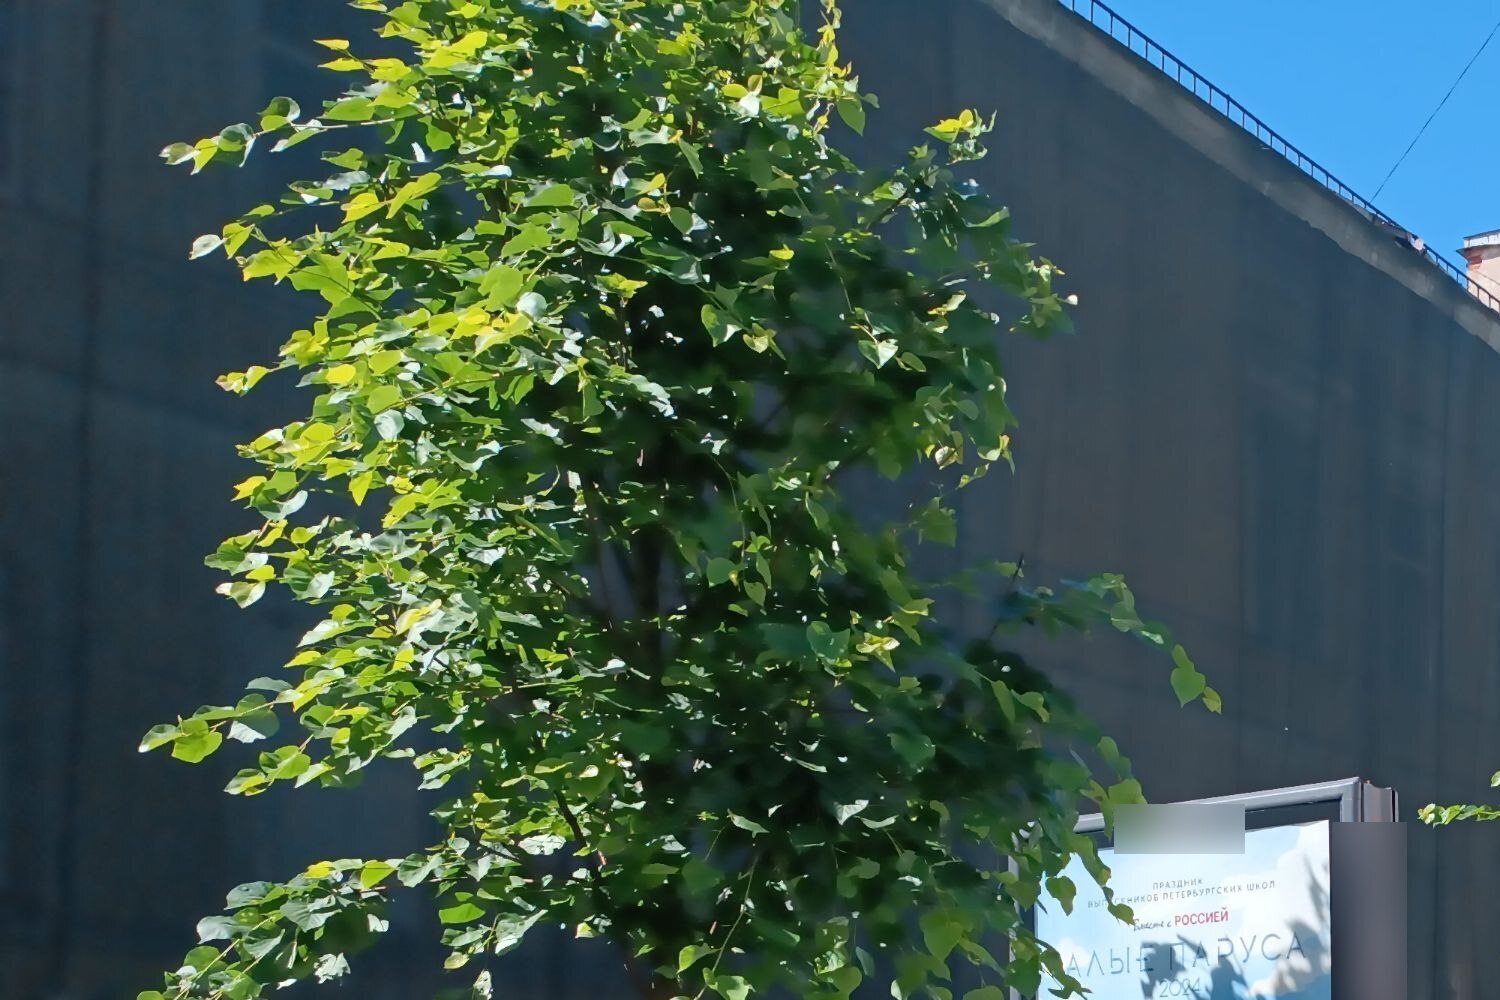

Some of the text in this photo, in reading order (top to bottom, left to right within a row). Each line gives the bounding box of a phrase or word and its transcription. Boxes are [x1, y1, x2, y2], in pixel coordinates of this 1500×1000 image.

[1152, 878, 1203, 890] ПРАЗДНИК
[1162, 884, 1242, 901] ПЕТЕРБУРГСКИХ
[1246, 880, 1276, 892] ШКОЛ
[1174, 906, 1229, 926] РОССИЕЙ
[1067, 931, 1307, 978] АЛЫЕ ПАРУСА
[1159, 977, 1201, 998] 2024
